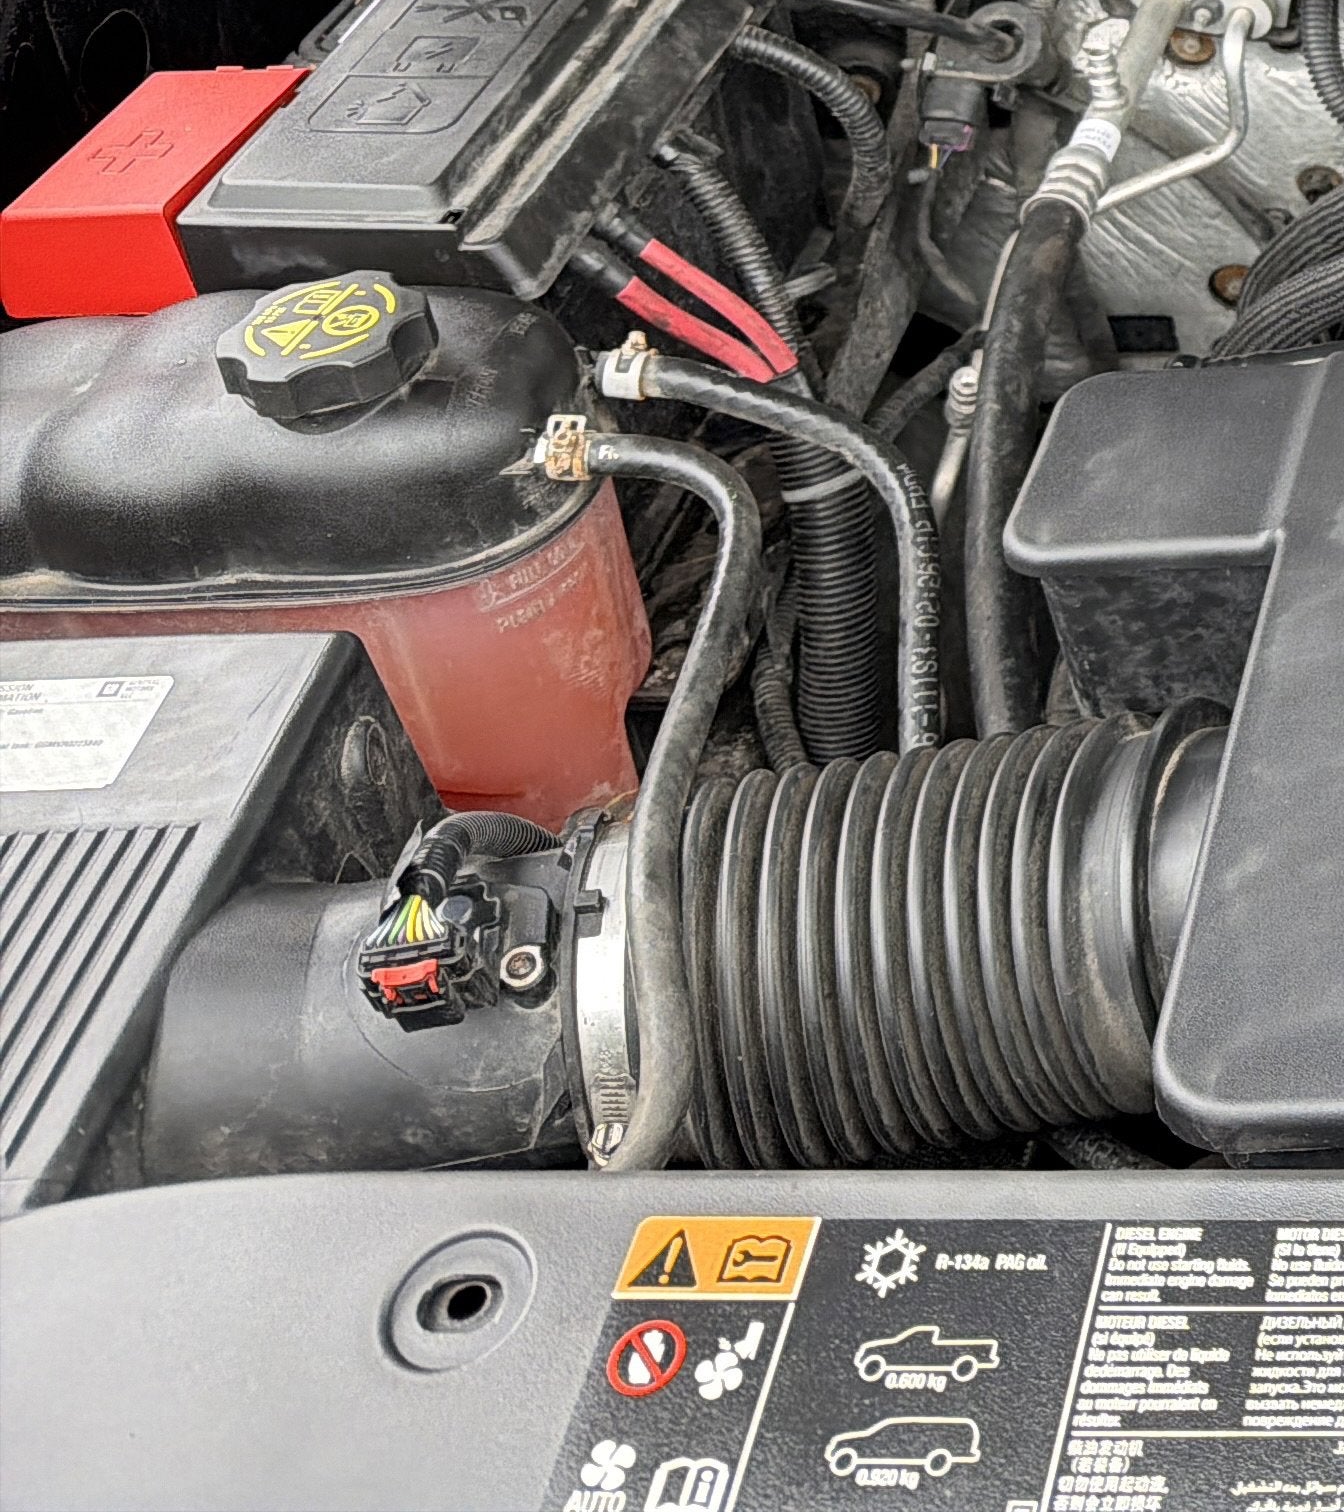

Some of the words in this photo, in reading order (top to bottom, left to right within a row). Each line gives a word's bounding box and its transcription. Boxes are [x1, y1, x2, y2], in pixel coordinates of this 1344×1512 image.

[935, 1253, 990, 1270] R-134a
[994, 1253, 1026, 1270] PAG
[563, 1490, 627, 1512] AUTO
